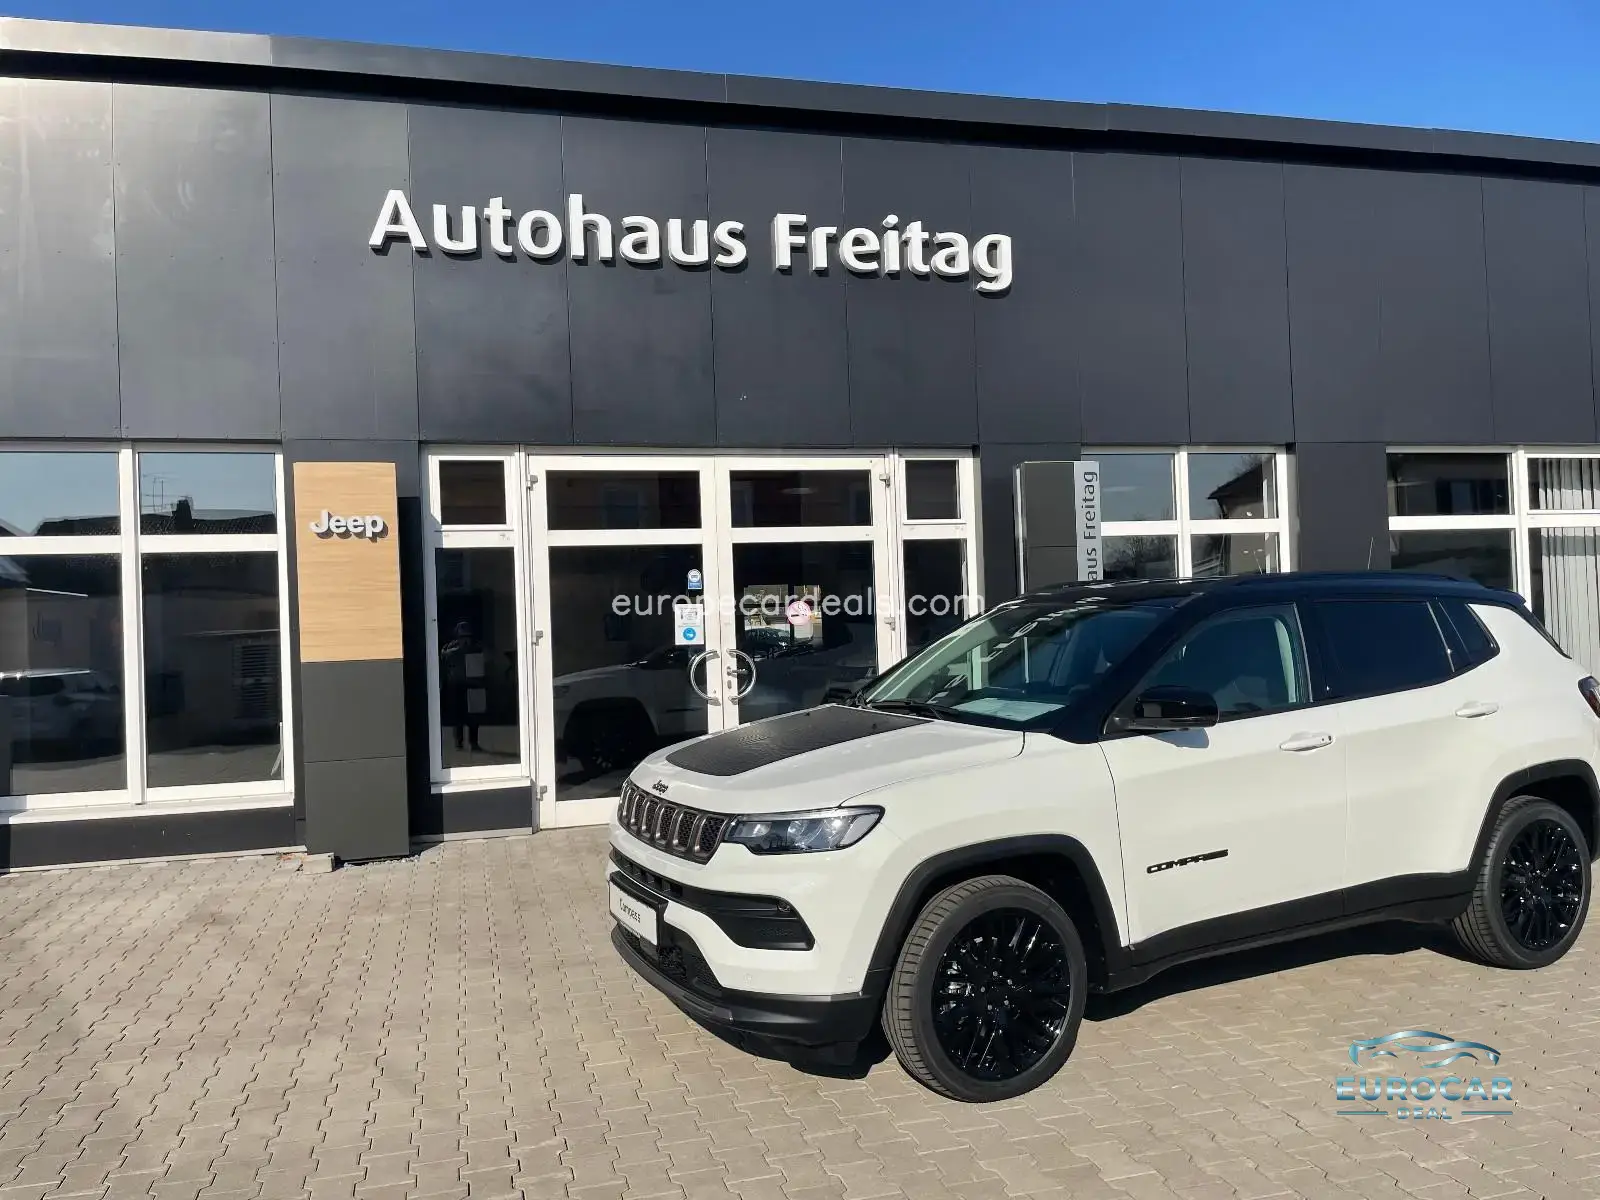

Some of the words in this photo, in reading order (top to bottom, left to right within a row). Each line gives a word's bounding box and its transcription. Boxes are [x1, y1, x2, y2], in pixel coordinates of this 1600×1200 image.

[368, 188, 749, 269] Autohaus
[773, 212, 1014, 293] Freitag
[309, 508, 385, 538] Jeep
[1081, 471, 1098, 540] Freitag
